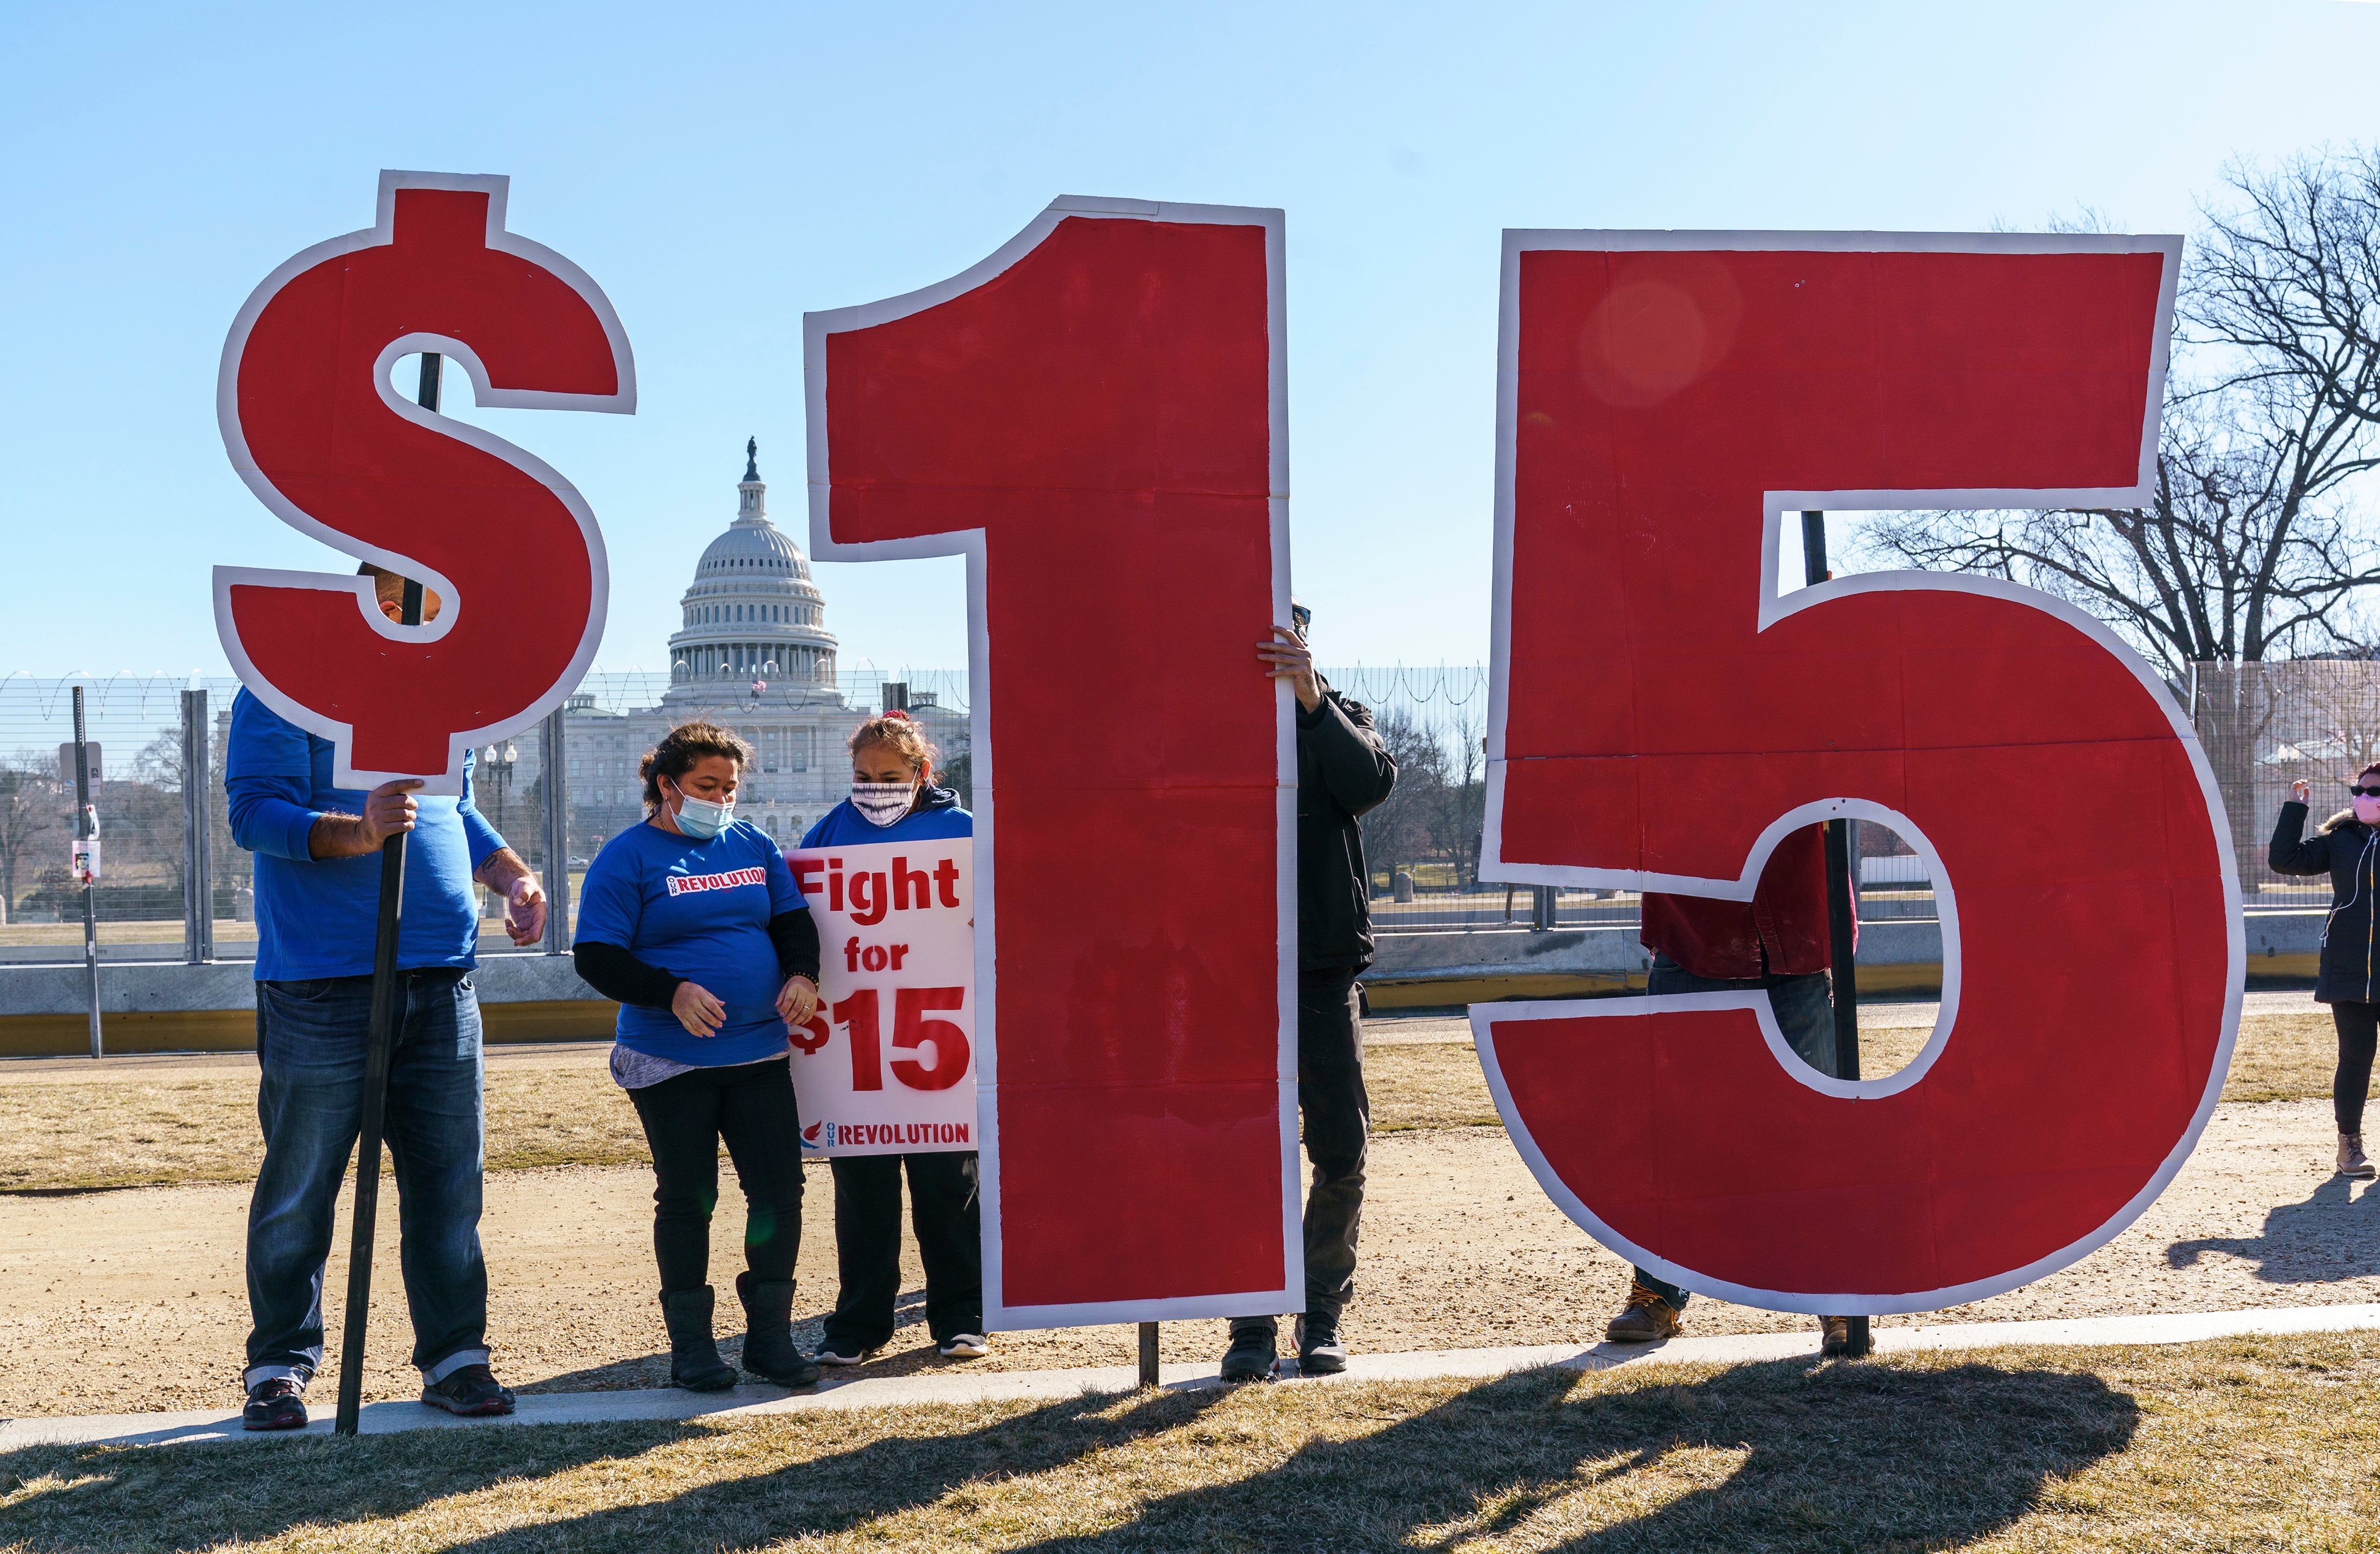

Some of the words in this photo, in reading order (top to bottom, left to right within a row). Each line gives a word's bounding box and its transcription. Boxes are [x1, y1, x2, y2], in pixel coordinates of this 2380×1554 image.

[668, 878, 678, 894] OUR
[676, 868, 765, 892] REVOLUTION
[788, 856, 960, 926] Fight
[844, 936, 909, 972] for
[789, 986, 970, 1091] $15
[826, 1122, 836, 1148] OUR
[838, 1122, 969, 1146] REVOLUTION
